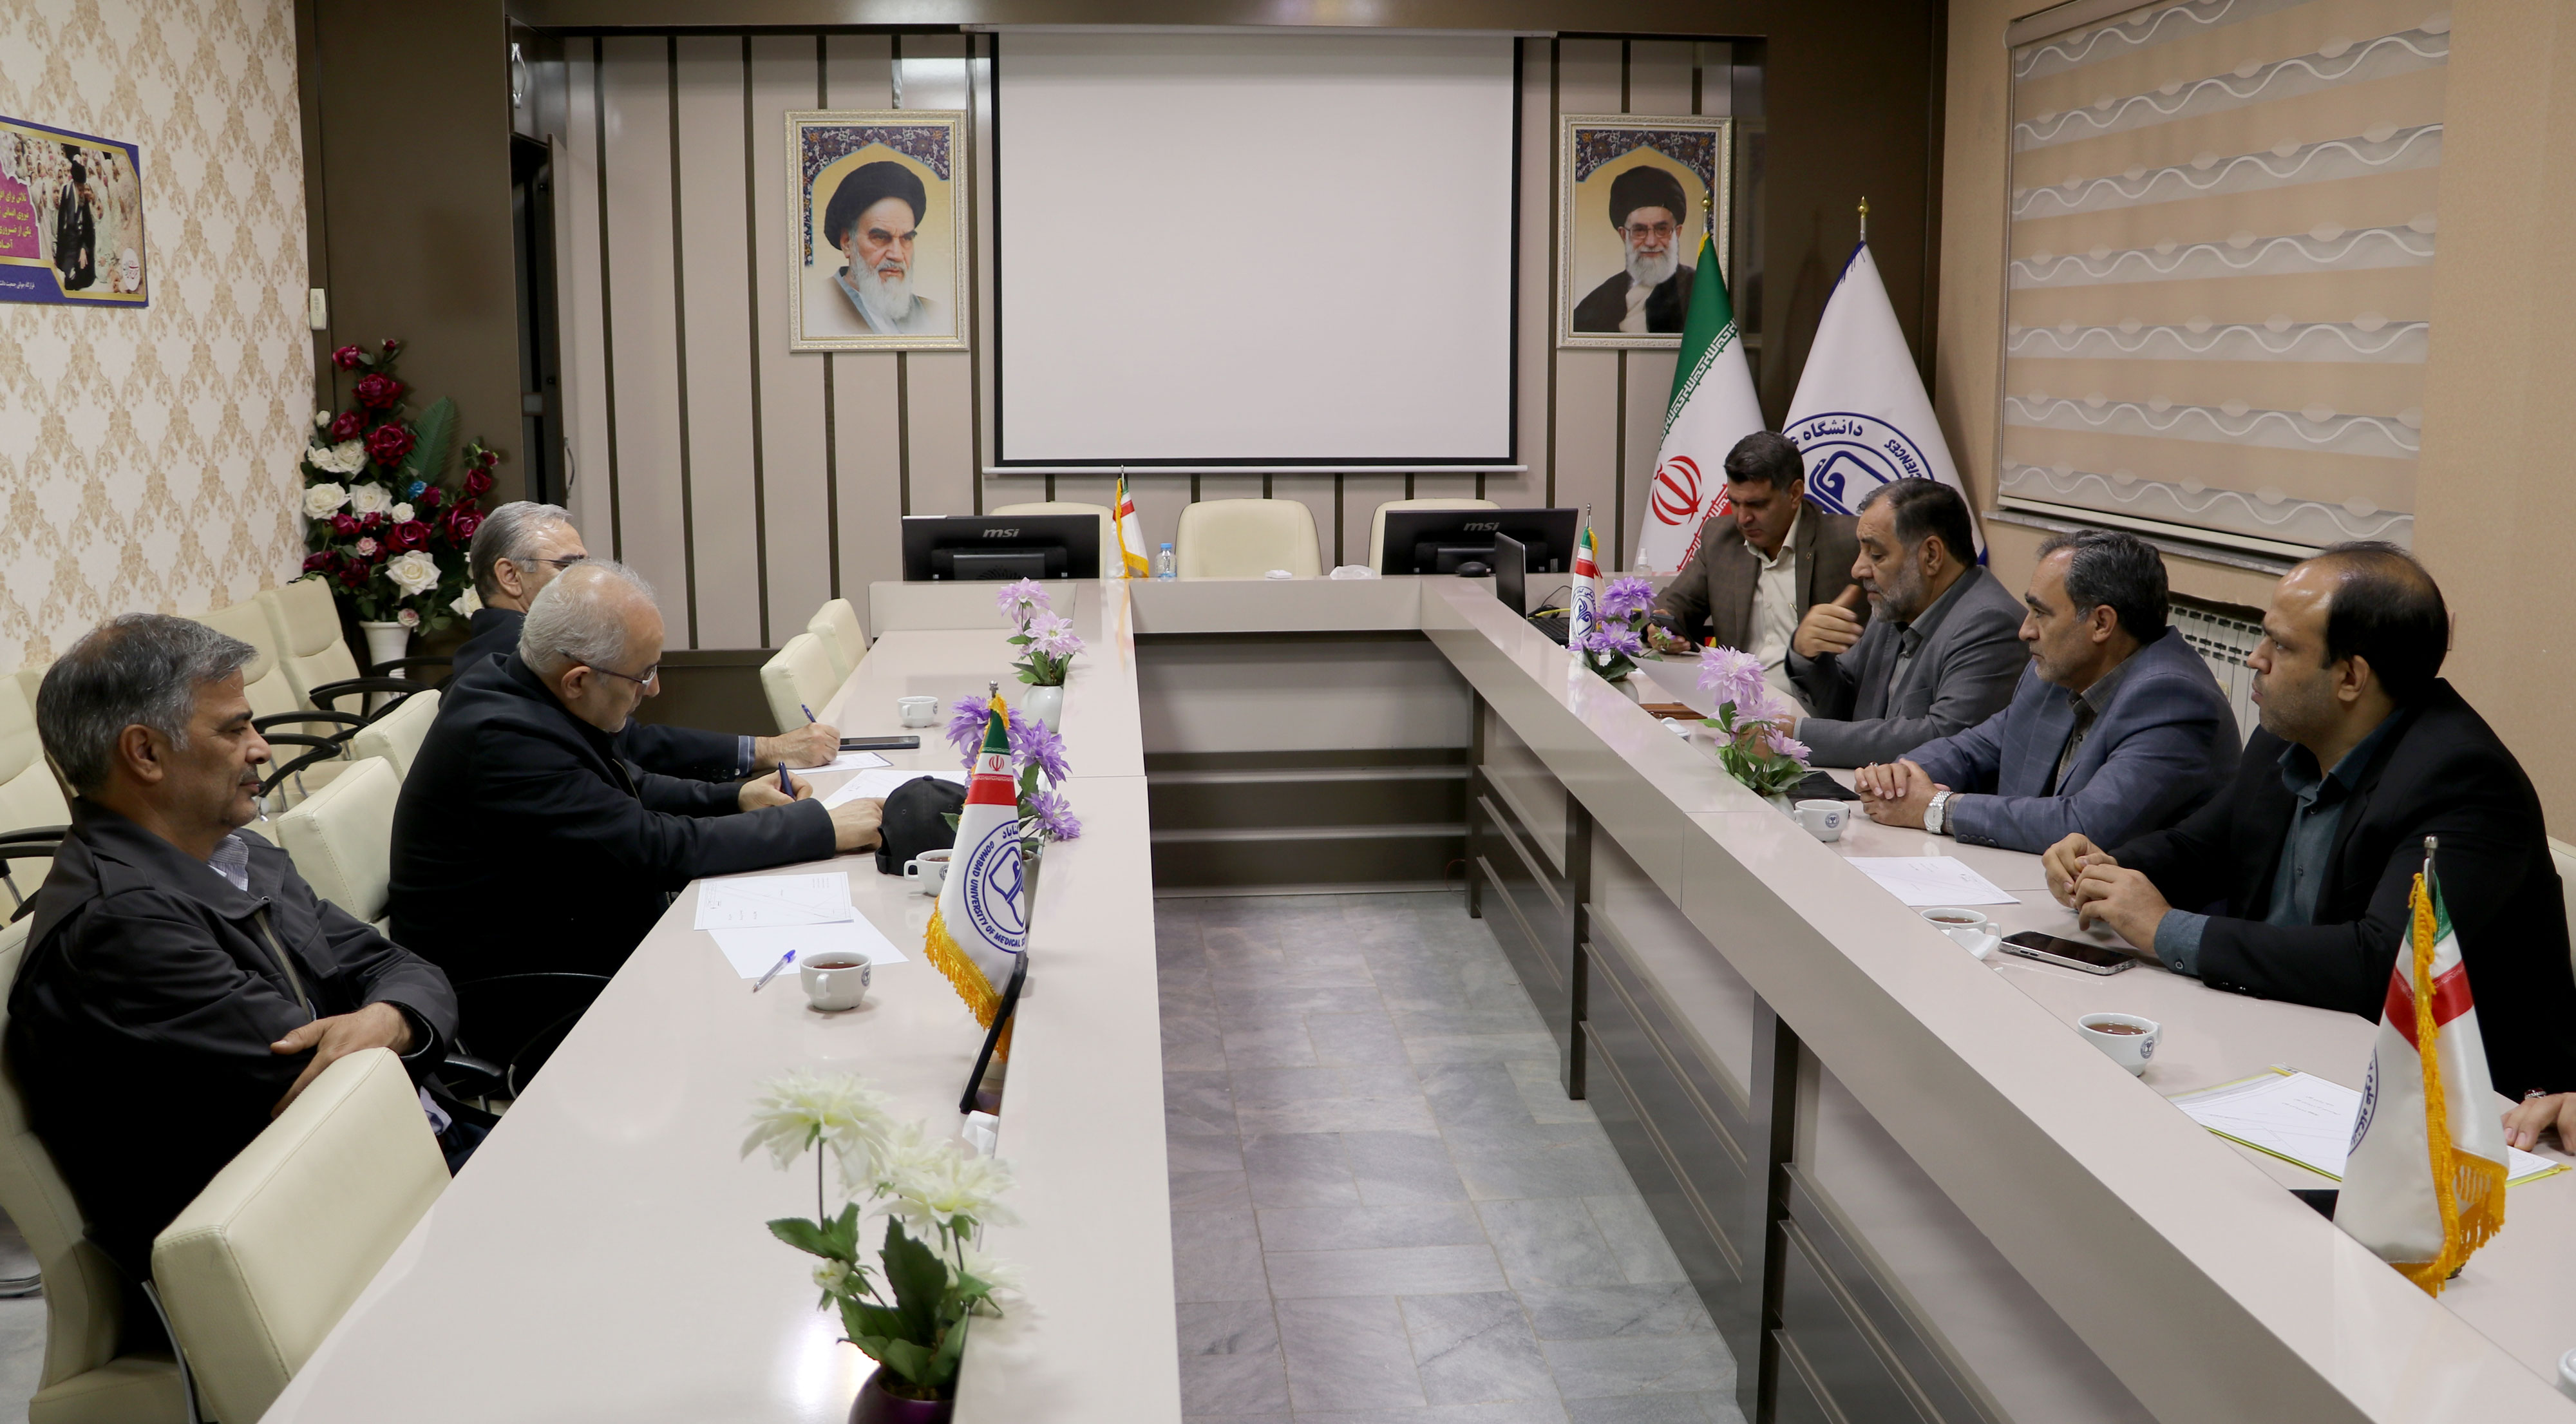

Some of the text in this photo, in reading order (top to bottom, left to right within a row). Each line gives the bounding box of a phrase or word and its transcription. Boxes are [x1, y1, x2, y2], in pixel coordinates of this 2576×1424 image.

[1803, 419, 1863, 441] دانشگاه
[1884, 439, 1922, 478] CIENCES
[983, 528, 1019, 538] msi
[1463, 522, 1500, 531] msi
[971, 840, 1020, 947] GONABAD UNIVERSITY OF MEDICAL
